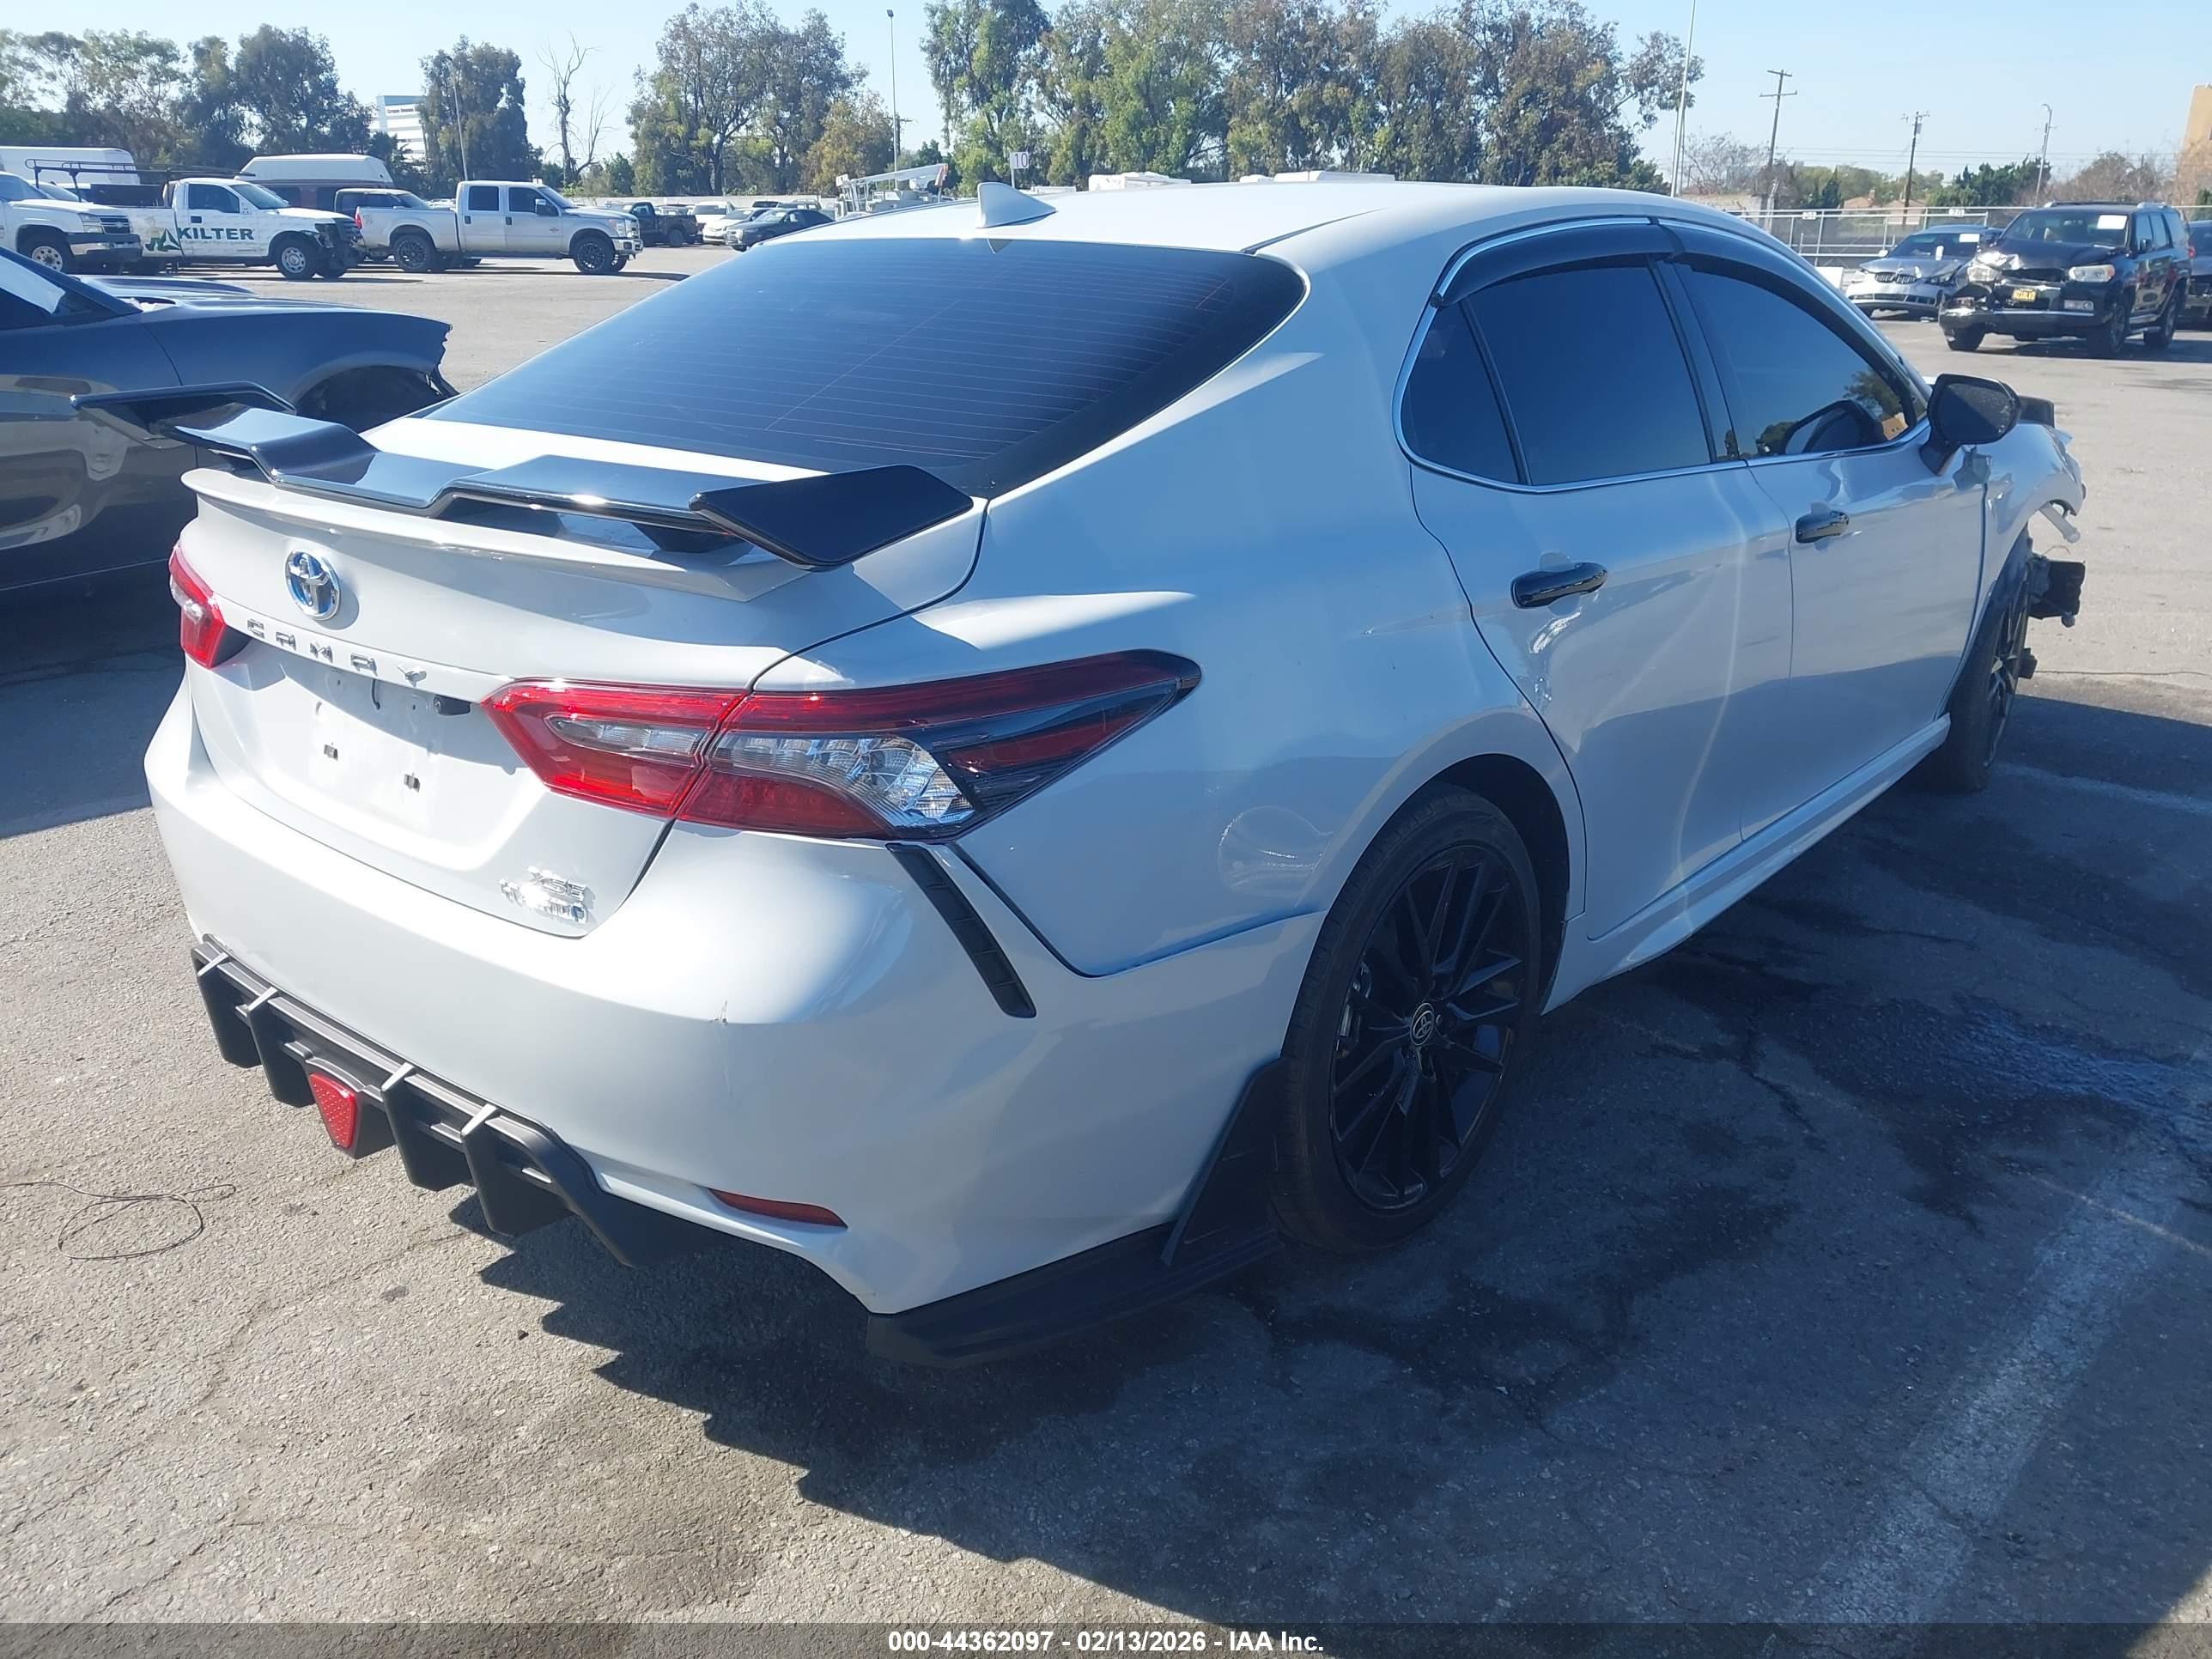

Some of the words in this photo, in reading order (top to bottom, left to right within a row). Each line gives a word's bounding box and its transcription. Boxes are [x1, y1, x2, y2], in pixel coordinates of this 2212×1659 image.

[1014, 153, 1029, 168] 10
[178, 228, 254, 240] KILTER
[246, 618, 428, 687] CAMRY
